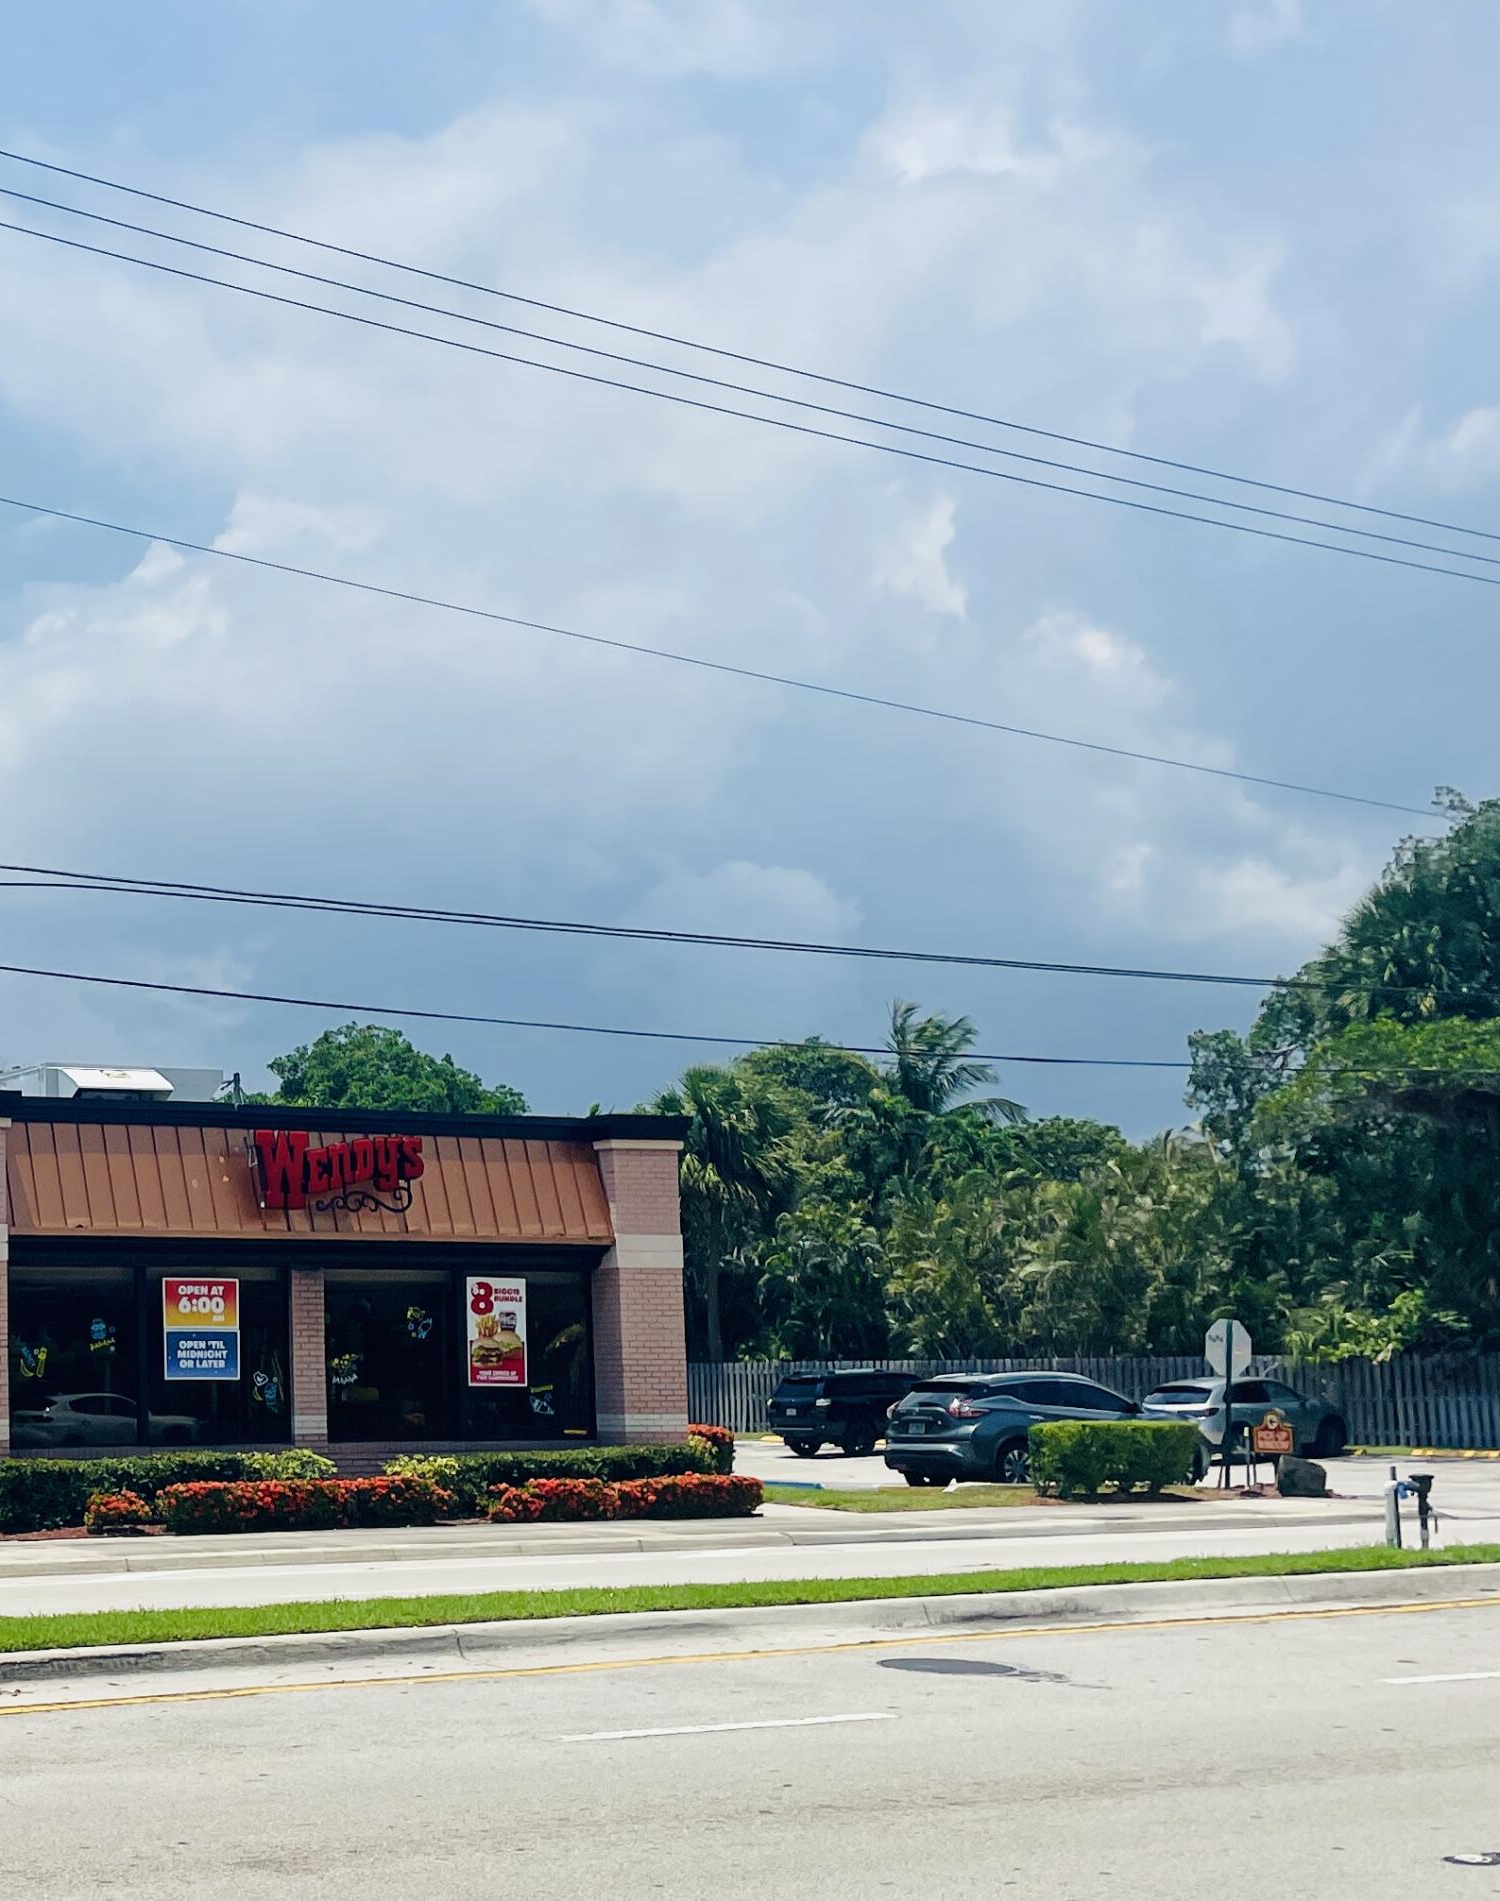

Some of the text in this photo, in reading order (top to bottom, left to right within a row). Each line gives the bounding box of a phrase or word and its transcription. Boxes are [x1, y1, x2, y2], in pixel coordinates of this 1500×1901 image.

[254, 1129, 424, 1210] Wendy's
[178, 1285, 224, 1295] OPEN AT
[178, 1297, 225, 1313] 6:00
[178, 1341, 206, 1349] OPEN
[177, 1350, 228, 1359] MIDNIGHT
[179, 1360, 225, 1368] OR LATER
